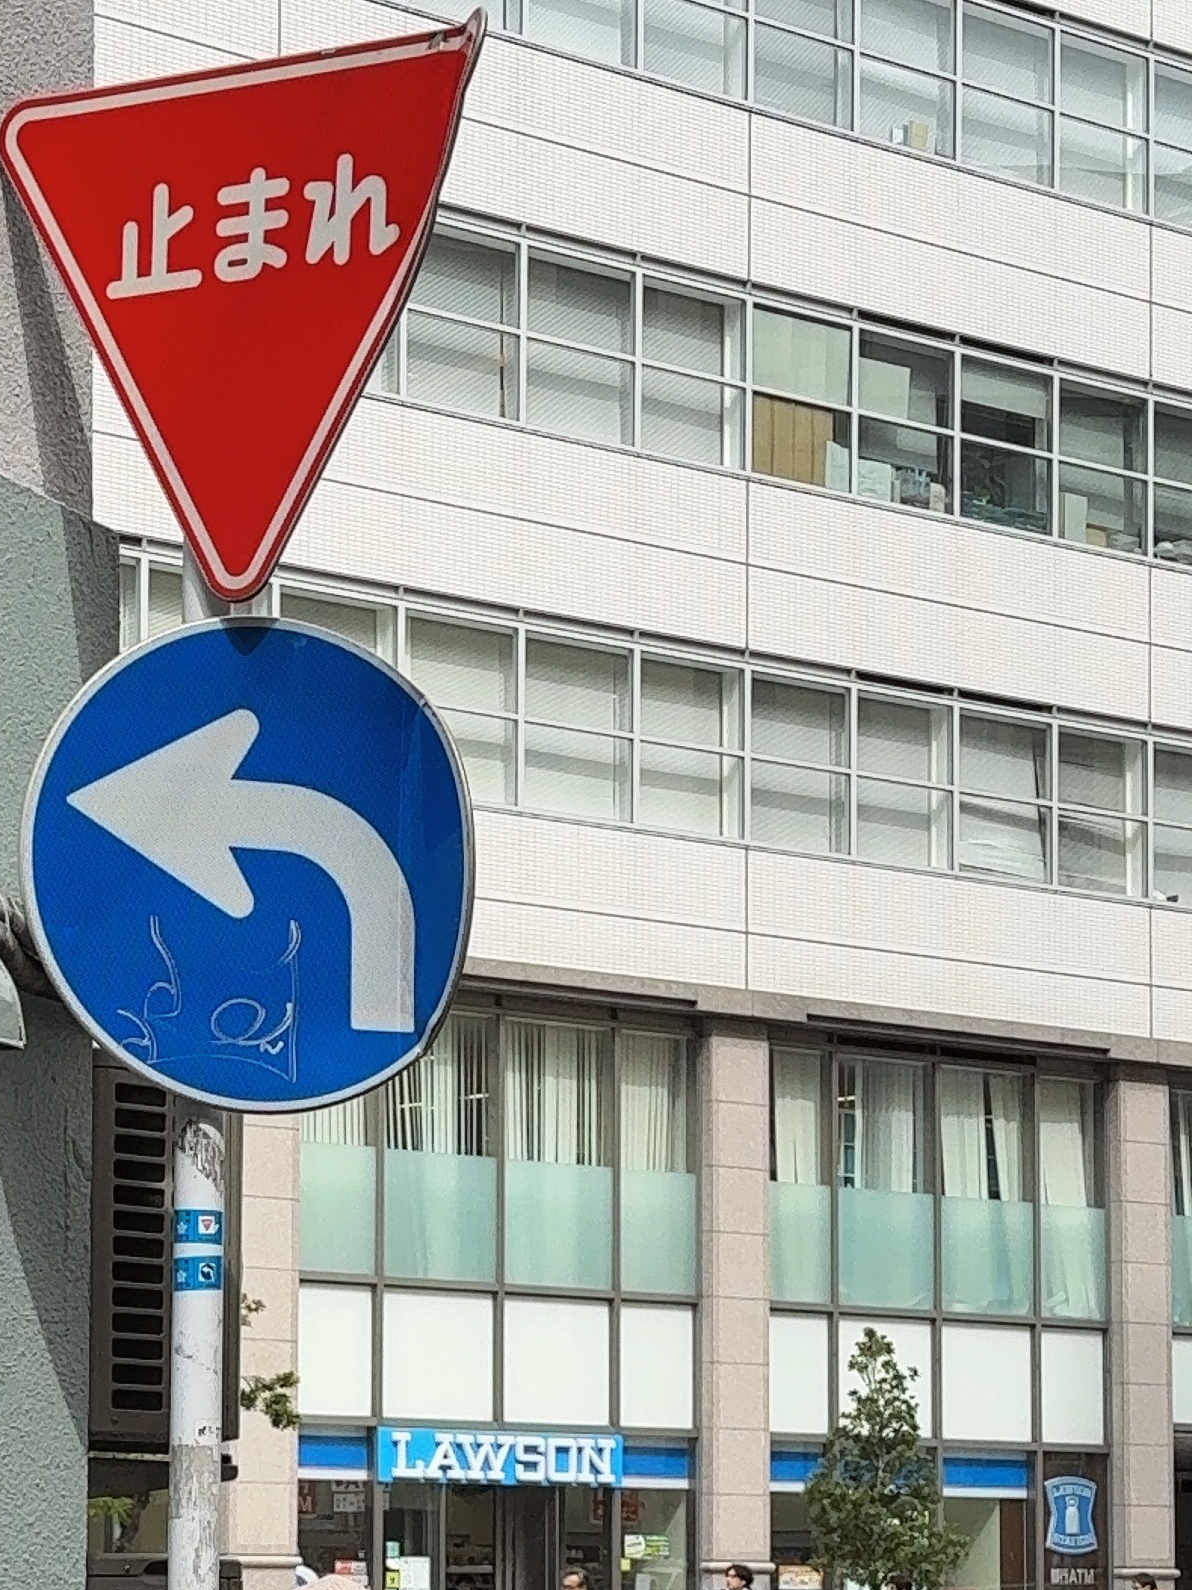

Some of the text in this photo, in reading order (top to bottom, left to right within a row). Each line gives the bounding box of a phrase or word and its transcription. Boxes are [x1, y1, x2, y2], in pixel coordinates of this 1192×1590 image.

[105, 153, 400, 299] 止まれ
[390, 1430, 617, 1486] LAWSON
